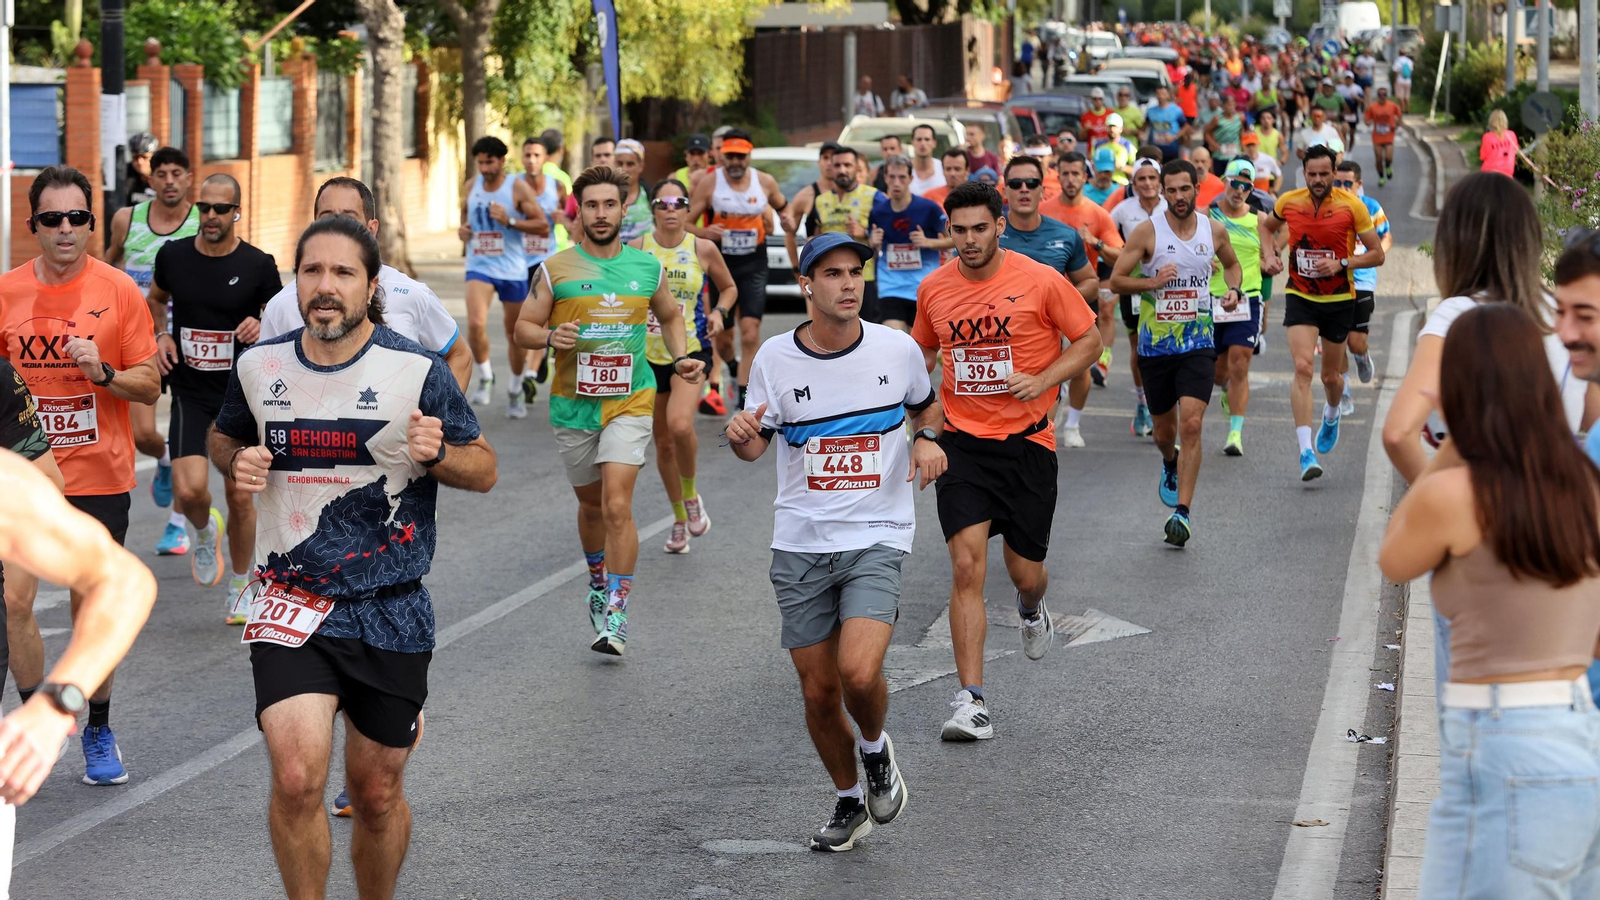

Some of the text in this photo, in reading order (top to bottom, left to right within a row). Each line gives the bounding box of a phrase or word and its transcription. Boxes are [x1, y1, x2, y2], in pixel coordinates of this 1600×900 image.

[1166, 300, 1189, 311] 403
[948, 316, 1012, 342] XXIX
[193, 343, 217, 357] 191
[591, 368, 618, 382] 180
[967, 364, 997, 380] 396
[42, 413, 79, 431] 184
[270, 429, 357, 449] 58 BEHOBIA
[292, 447, 357, 459] SAN SEBASTIAN
[822, 454, 863, 474] 448
[287, 475, 350, 484] BEHOBIAREN BILA
[259, 599, 302, 625] 201
